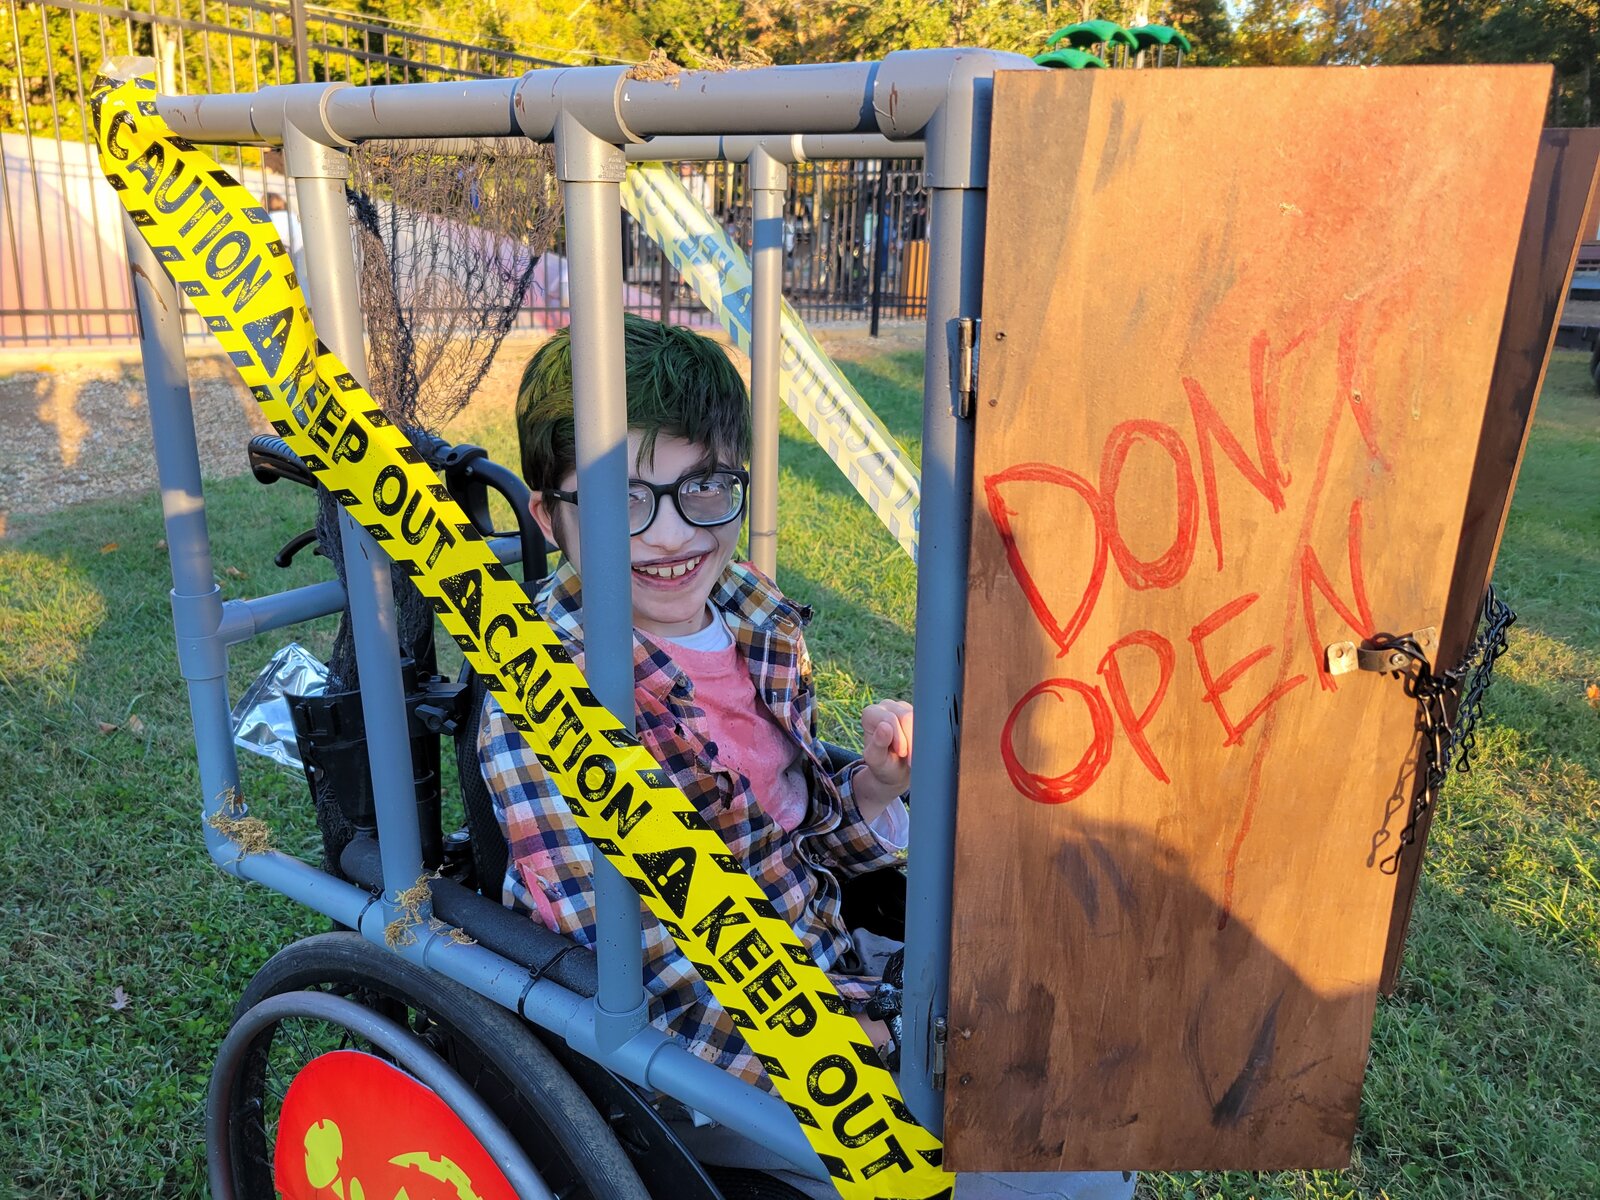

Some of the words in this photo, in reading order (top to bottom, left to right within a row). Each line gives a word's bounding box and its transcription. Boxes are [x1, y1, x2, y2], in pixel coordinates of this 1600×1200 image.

[107, 110, 272, 313] CAUTION
[279, 345, 369, 465] KEEP
[373, 465, 456, 569] OUT
[484, 613, 653, 838] CAUTION
[692, 896, 818, 1037] KEEP
[806, 1054, 915, 1180] OUT
[1000, 499, 1378, 805] OPEN
